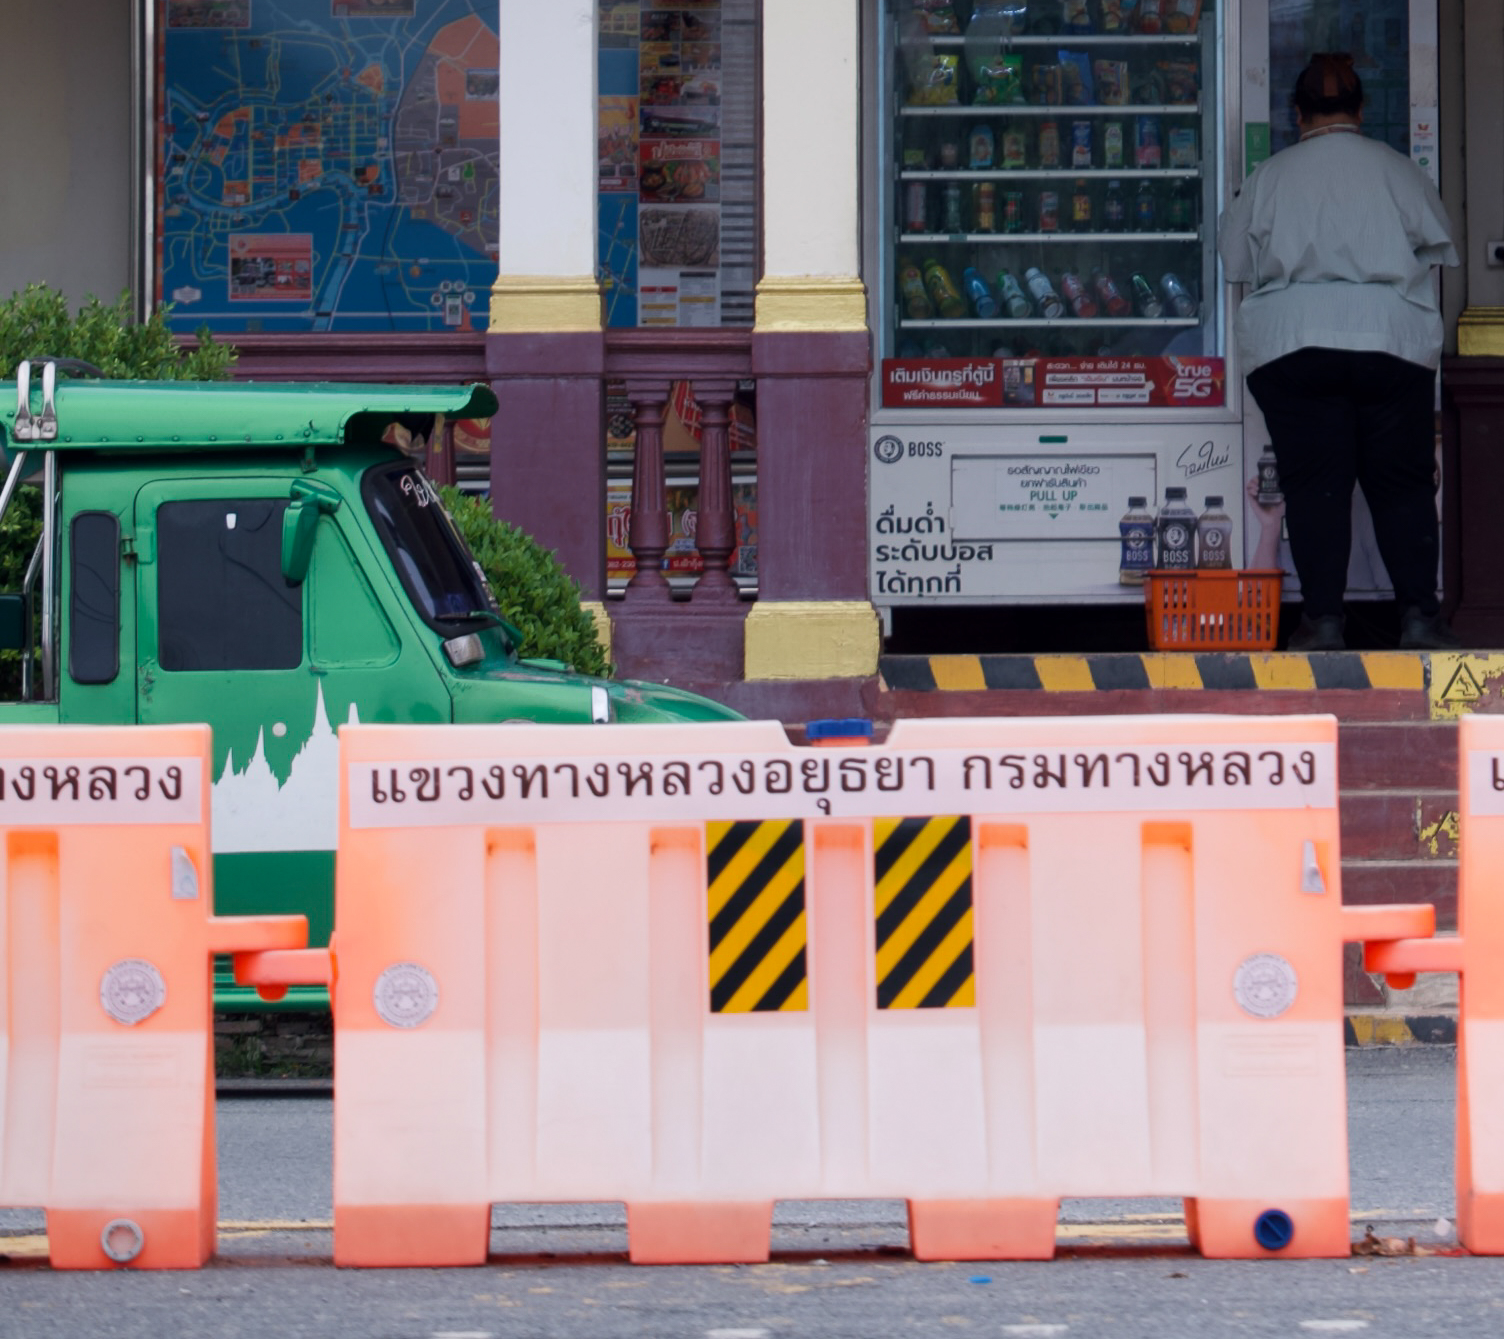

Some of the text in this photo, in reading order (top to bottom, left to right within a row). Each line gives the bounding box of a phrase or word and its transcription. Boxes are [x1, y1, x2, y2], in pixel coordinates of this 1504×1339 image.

[1176, 363, 1212, 378] true
[1173, 378, 1213, 398] 5G
[908, 441, 943, 458] BOSS
[1007, 463, 1101, 475] รอสัญญาณไฟเขียว
[1029, 490, 1078, 502] PULL UP
[875, 501, 946, 535] ดื่มด่ำ
[875, 538, 994, 563] ระดับบอส
[1126, 550, 1149, 562] BOSS
[1163, 549, 1189, 563] BOSS
[1202, 550, 1225, 562] BOSS
[875, 563, 962, 598] ได้ทุกที่
[370, 751, 1317, 815] แขวงทางหลวงอยุธยา กรมทางหลวง
